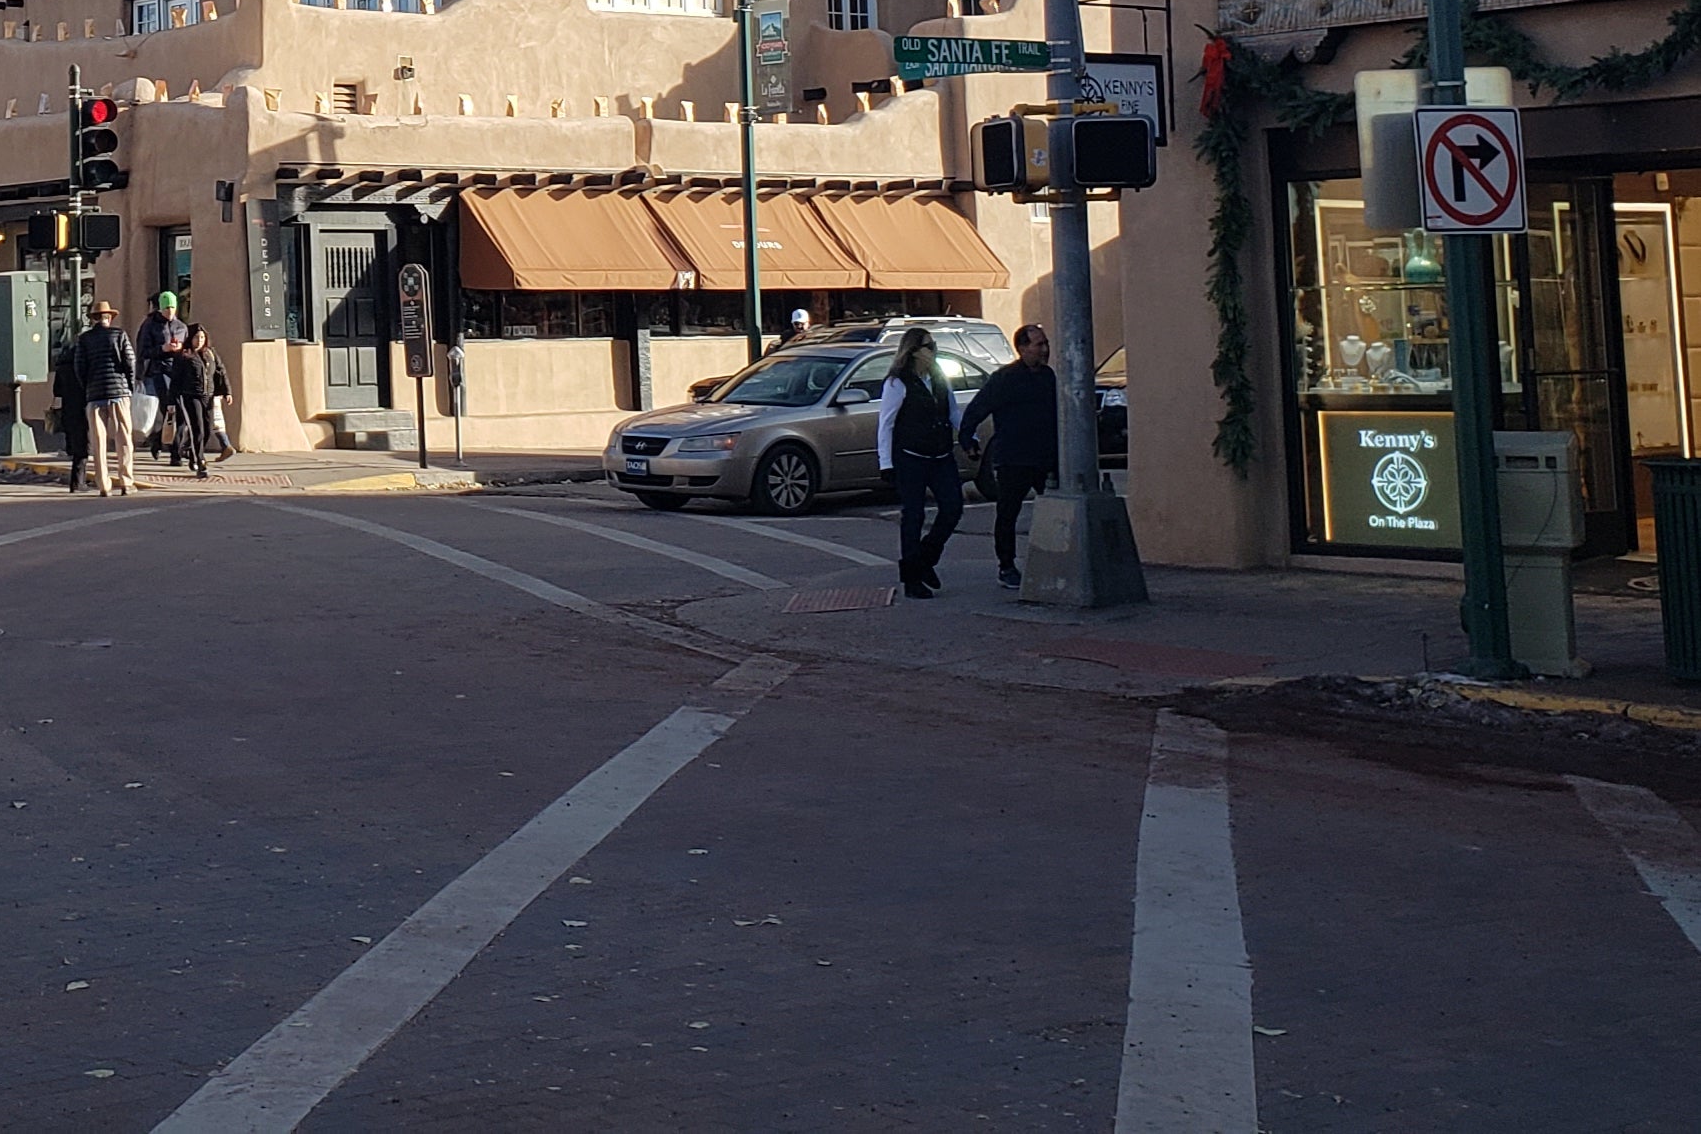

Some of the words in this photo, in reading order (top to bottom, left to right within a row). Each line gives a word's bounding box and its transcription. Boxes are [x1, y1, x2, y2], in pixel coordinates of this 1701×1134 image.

[901, 37, 921, 51] OLD
[927, 38, 984, 63] SANTA
[991, 40, 1011, 64] FE
[1017, 42, 1041, 56] TRAIL
[1104, 78, 1154, 97] KENNY'S
[732, 240, 783, 250] DEURS
[260, 238, 272, 317] DETOURS
[1358, 430, 1435, 452] Kenny's
[1368, 515, 1385, 527] On
[1386, 516, 1406, 528] The
[1407, 517, 1436, 530] Plaza
